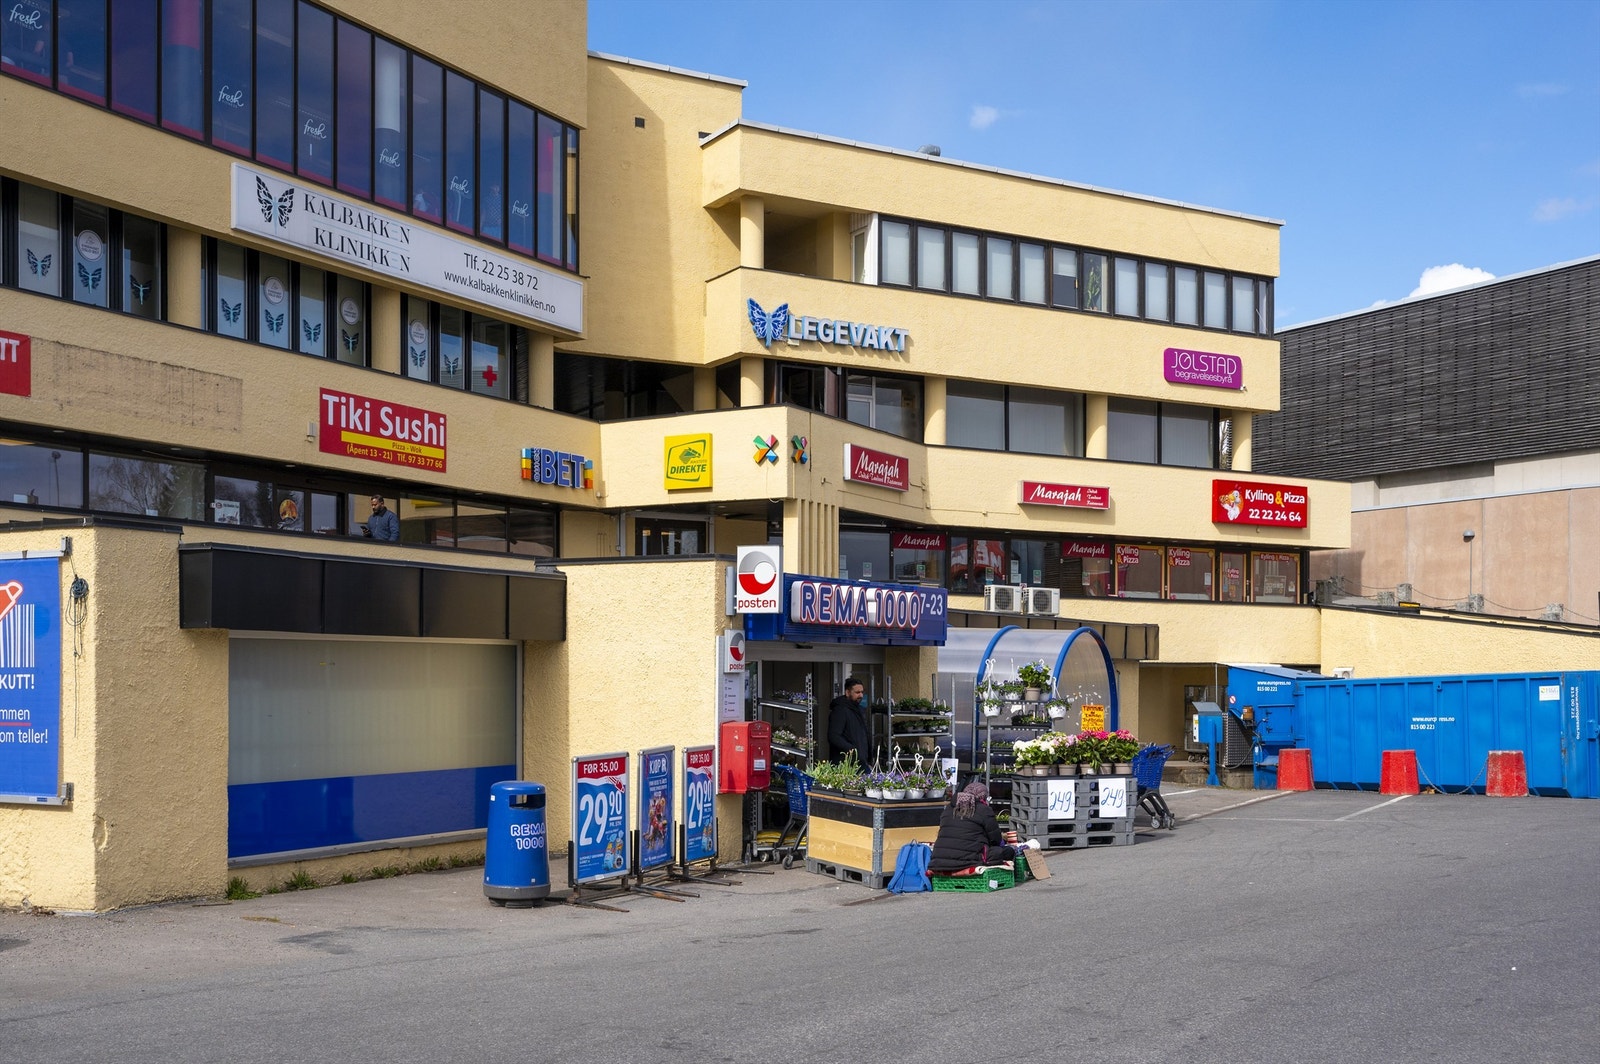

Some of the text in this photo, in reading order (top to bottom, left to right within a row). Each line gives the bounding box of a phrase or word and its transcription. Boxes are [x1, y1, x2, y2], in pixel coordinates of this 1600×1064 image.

[10, 4, 43, 29] fresh
[218, 85, 244, 107] fresh
[303, 118, 327, 139] fresh
[379, 148, 401, 167] fresh
[450, 175, 469, 194] fresh
[511, 200, 530, 217] fresh
[463, 252, 539, 291] Tlf. 22 25 38 72
[443, 270, 556, 314] www.kalbakkenklinikken.no
[787, 313, 909, 353] LEGEVAKT
[1171, 351, 1237, 375] JØLSTAD
[1175, 369, 1233, 384] begravelsesbyrå
[322, 393, 445, 447] Tiki Sushi
[369, 448, 378, 457] 13
[382, 450, 393, 460] 21)
[391, 442, 406, 451] Pizza
[409, 445, 423, 454] Wok
[407, 455, 417, 464] 97
[417, 457, 426, 466] 33
[426, 459, 434, 467] 77
[434, 460, 443, 469] 66
[540, 447, 585, 489] BET
[670, 463, 707, 475] DIREKTE
[854, 450, 900, 484] Marajah
[1029, 484, 1082, 506] Marajah
[1245, 488, 1306, 508] Kylling & Pizza
[1248, 508, 1302, 522] 22 22 24 64
[898, 534, 941, 550] Marajah
[1067, 542, 1105, 558] Marajah
[1116, 546, 1140, 556] Kylling
[1117, 554, 1139, 564] & Pizza
[1168, 548, 1191, 559] Kylling
[1168, 557, 1191, 566] & Pizza
[738, 597, 777, 611] posten
[801, 582, 920, 630] REMA 1000
[920, 593, 943, 616] 7-23
[0, 673, 35, 690] KUTT!
[1570, 698, 1574, 706] 00
[17, 728, 48, 744] teller!
[690, 753, 710, 764] FØR 35,00
[583, 761, 619, 774] FØR 35,00
[510, 822, 546, 836] REMA
[516, 836, 544, 849] 1000
